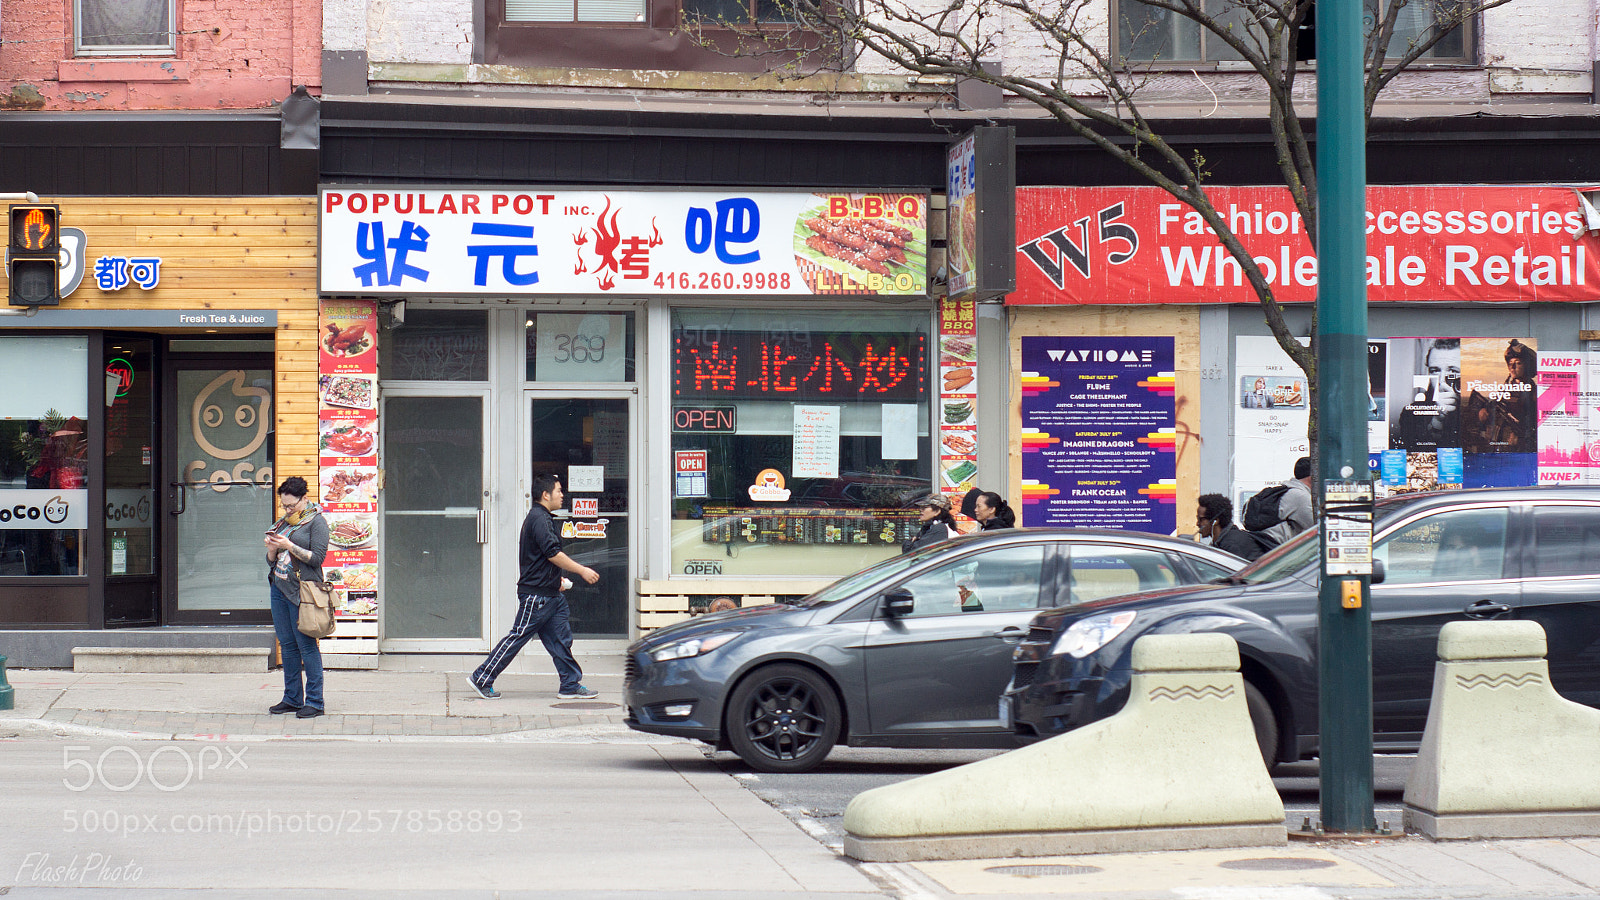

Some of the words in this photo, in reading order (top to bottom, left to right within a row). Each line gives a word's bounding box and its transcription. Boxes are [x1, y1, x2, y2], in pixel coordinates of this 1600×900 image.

[326, 192, 482, 215] POPULAR
[491, 193, 555, 215] POT
[564, 205, 596, 216] INC.
[827, 195, 921, 221] B.B.Q
[1016, 201, 1139, 291] W5
[1161, 245, 1427, 287] Wholeale
[1445, 245, 1586, 287] Retail
[95, 256, 162, 290] 都可
[653, 271, 792, 290] 416.260.9988
[816, 272, 922, 292] L.L.B.O.
[179, 314, 207, 323] Fresh
[209, 314, 227, 323] Tea
[229, 314, 237, 323] &
[238, 314, 265, 323] Juice
[943, 321, 974, 331] BBQ
[554, 333, 606, 363] 369
[690, 341, 910, 392] 南北小炒
[1541, 358, 1573, 367] NXNE
[1086, 383, 1111, 391] FLUME
[1466, 380, 1532, 392] Passionate
[1488, 391, 1512, 402] eye
[1405, 404, 1446, 412] documentary
[674, 409, 733, 429] OPEN
[1063, 440, 1096, 448] IMAGINE
[1096, 440, 1135, 448] DRAGONS
[680, 458, 703, 470] OPEN
[183, 460, 273, 492] CoCo
[1540, 472, 1572, 481] NXNE
[574, 500, 597, 509] ATM
[106, 502, 136, 521] CoCo
[113, 542, 125, 550] PASS
[683, 564, 722, 575] OPEN
